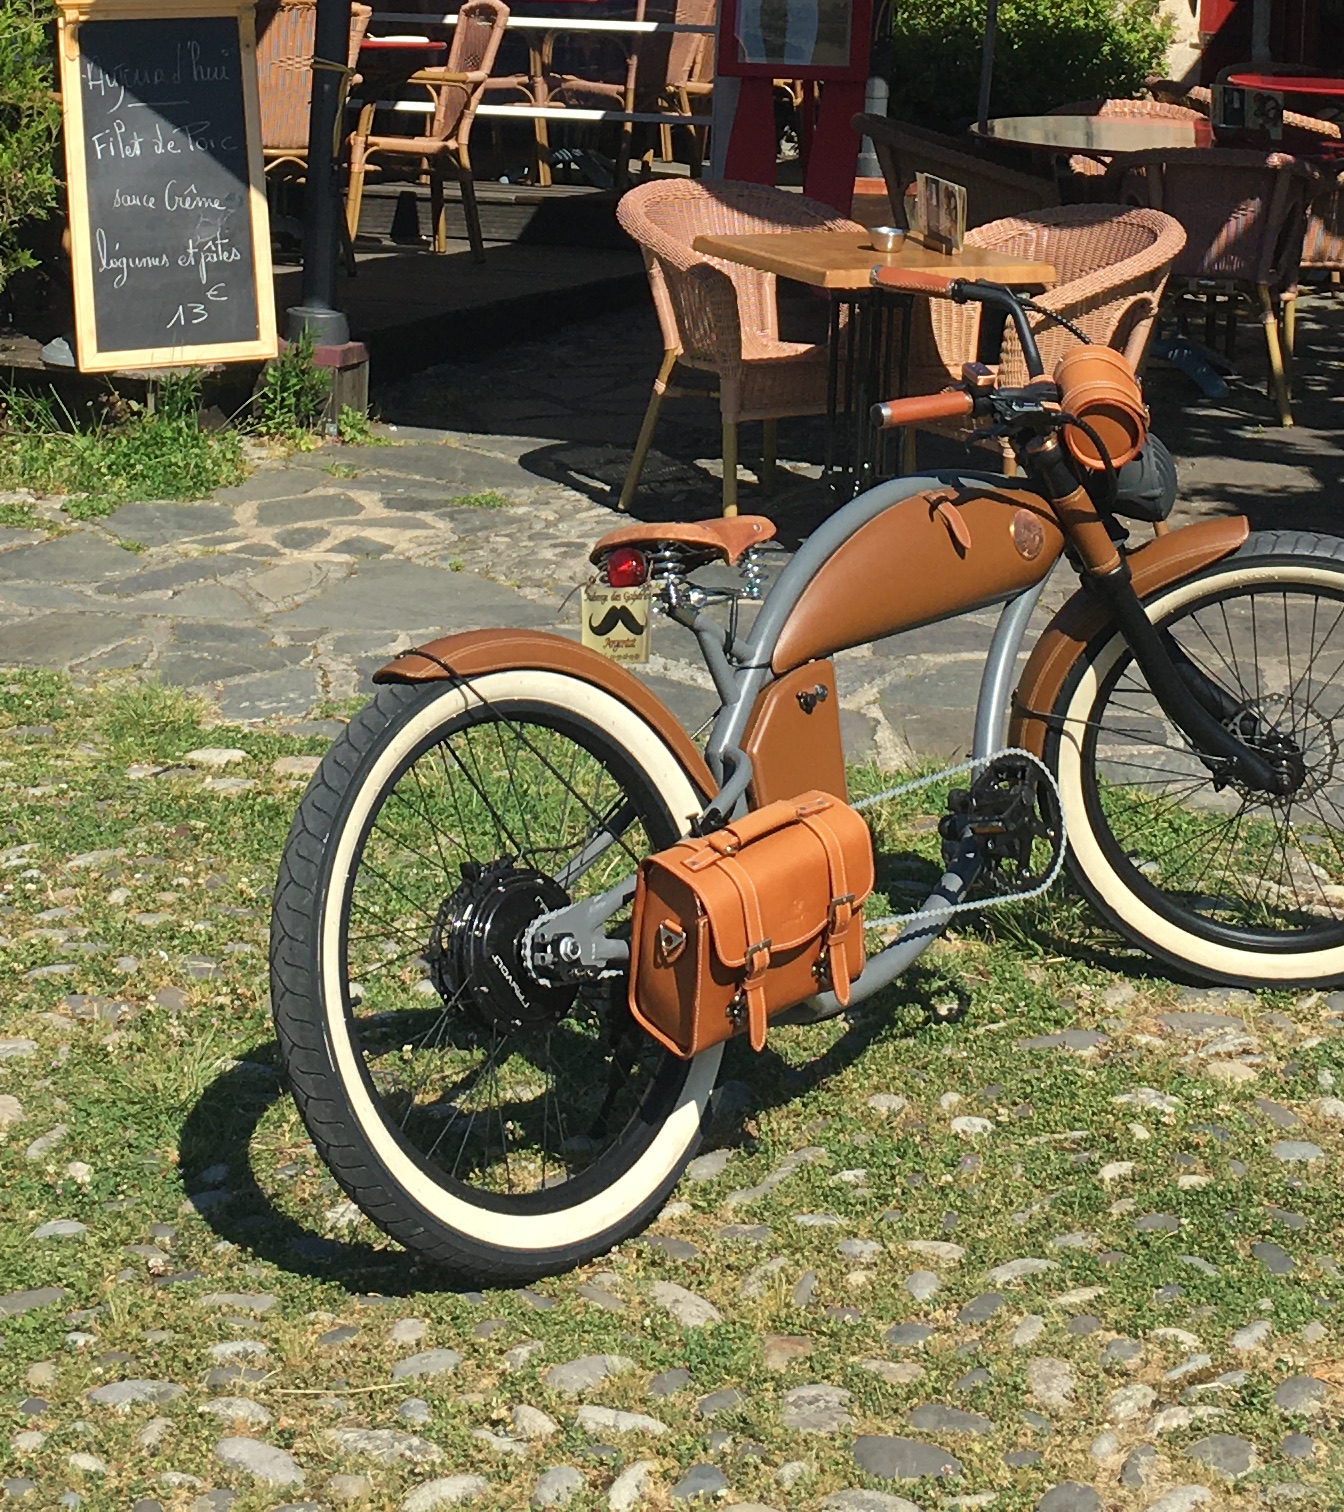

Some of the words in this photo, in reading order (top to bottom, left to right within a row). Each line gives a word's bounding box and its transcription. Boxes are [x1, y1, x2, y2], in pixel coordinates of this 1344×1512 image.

[91, 119, 144, 160] Filet
[152, 123, 181, 154] de
[112, 188, 157, 209] sauce
[177, 238, 199, 267] et
